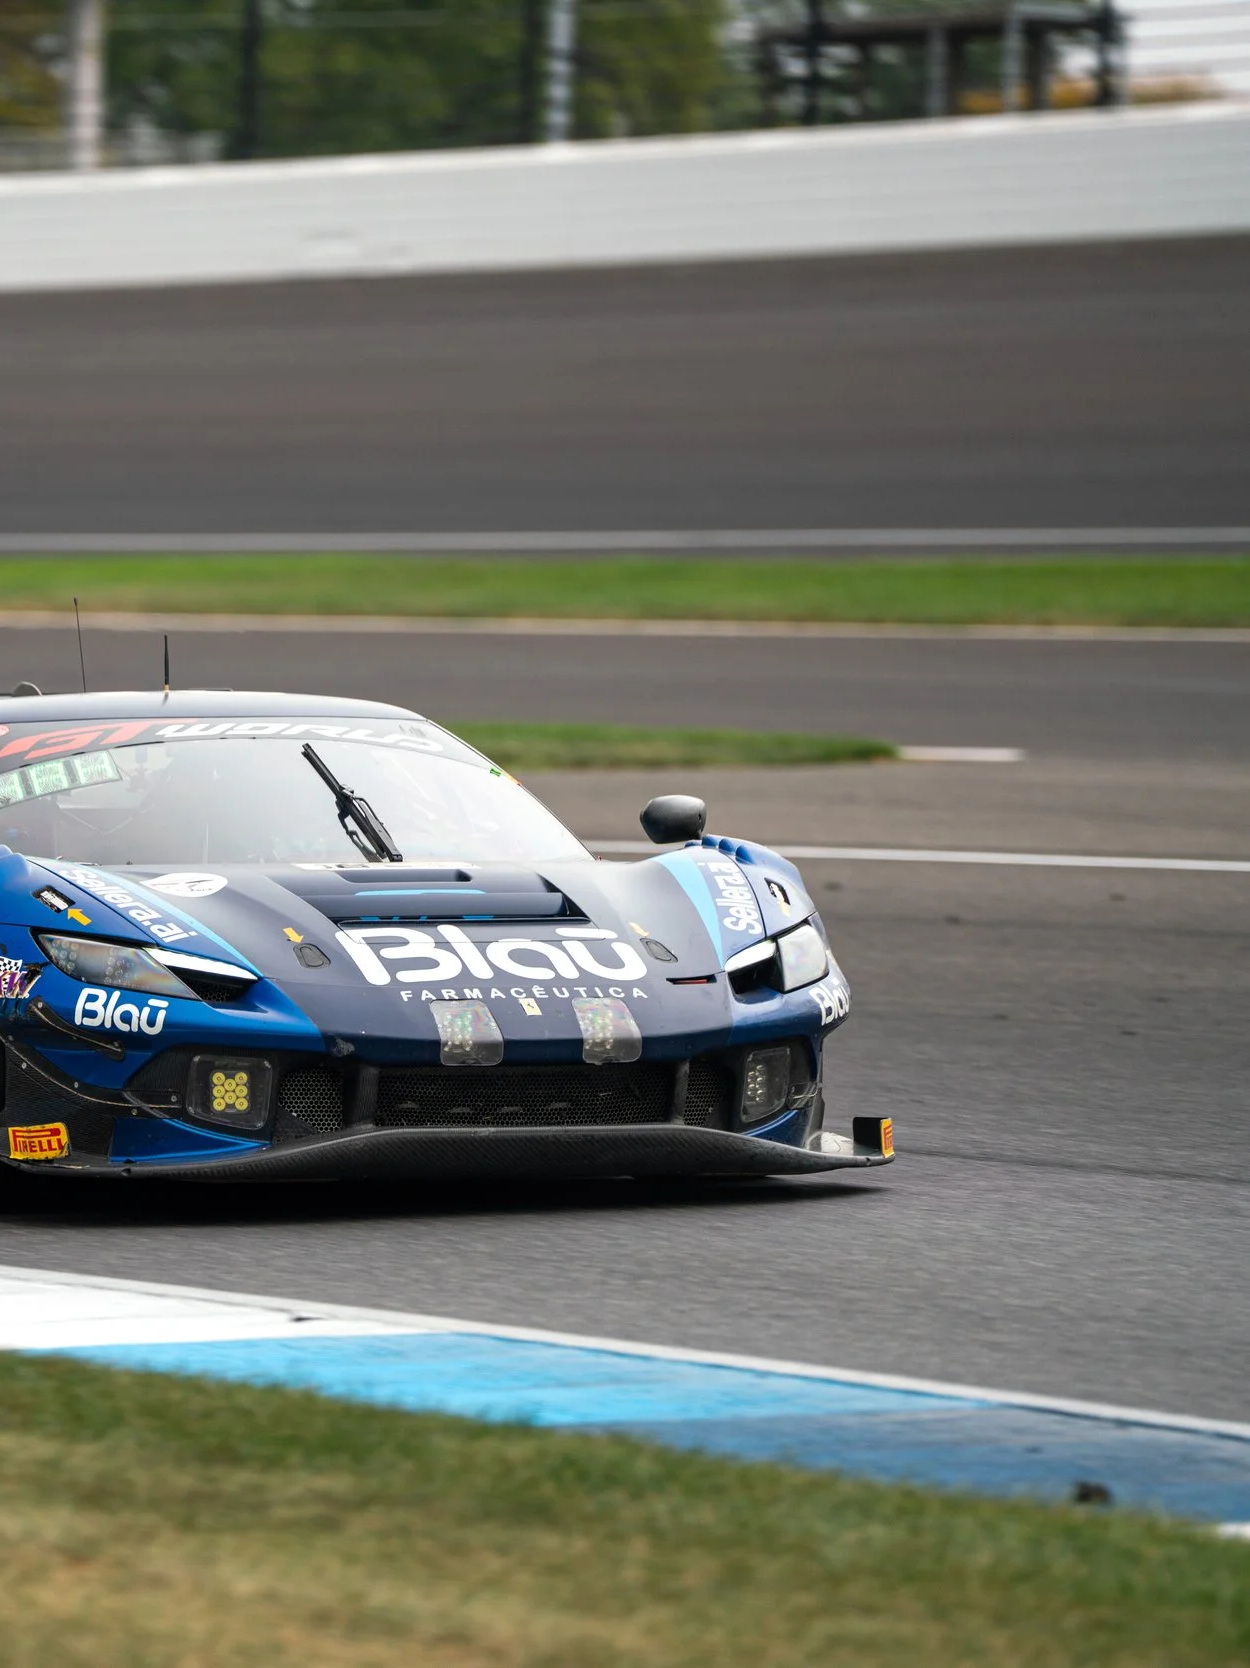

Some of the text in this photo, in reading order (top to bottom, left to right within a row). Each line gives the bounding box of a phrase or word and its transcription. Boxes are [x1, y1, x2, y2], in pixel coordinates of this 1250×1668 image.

[155, 722, 444, 751] WORLD
[400, 984, 649, 1002] FARMACÊUTICA
[12, 1127, 64, 1154] PIRELLI
